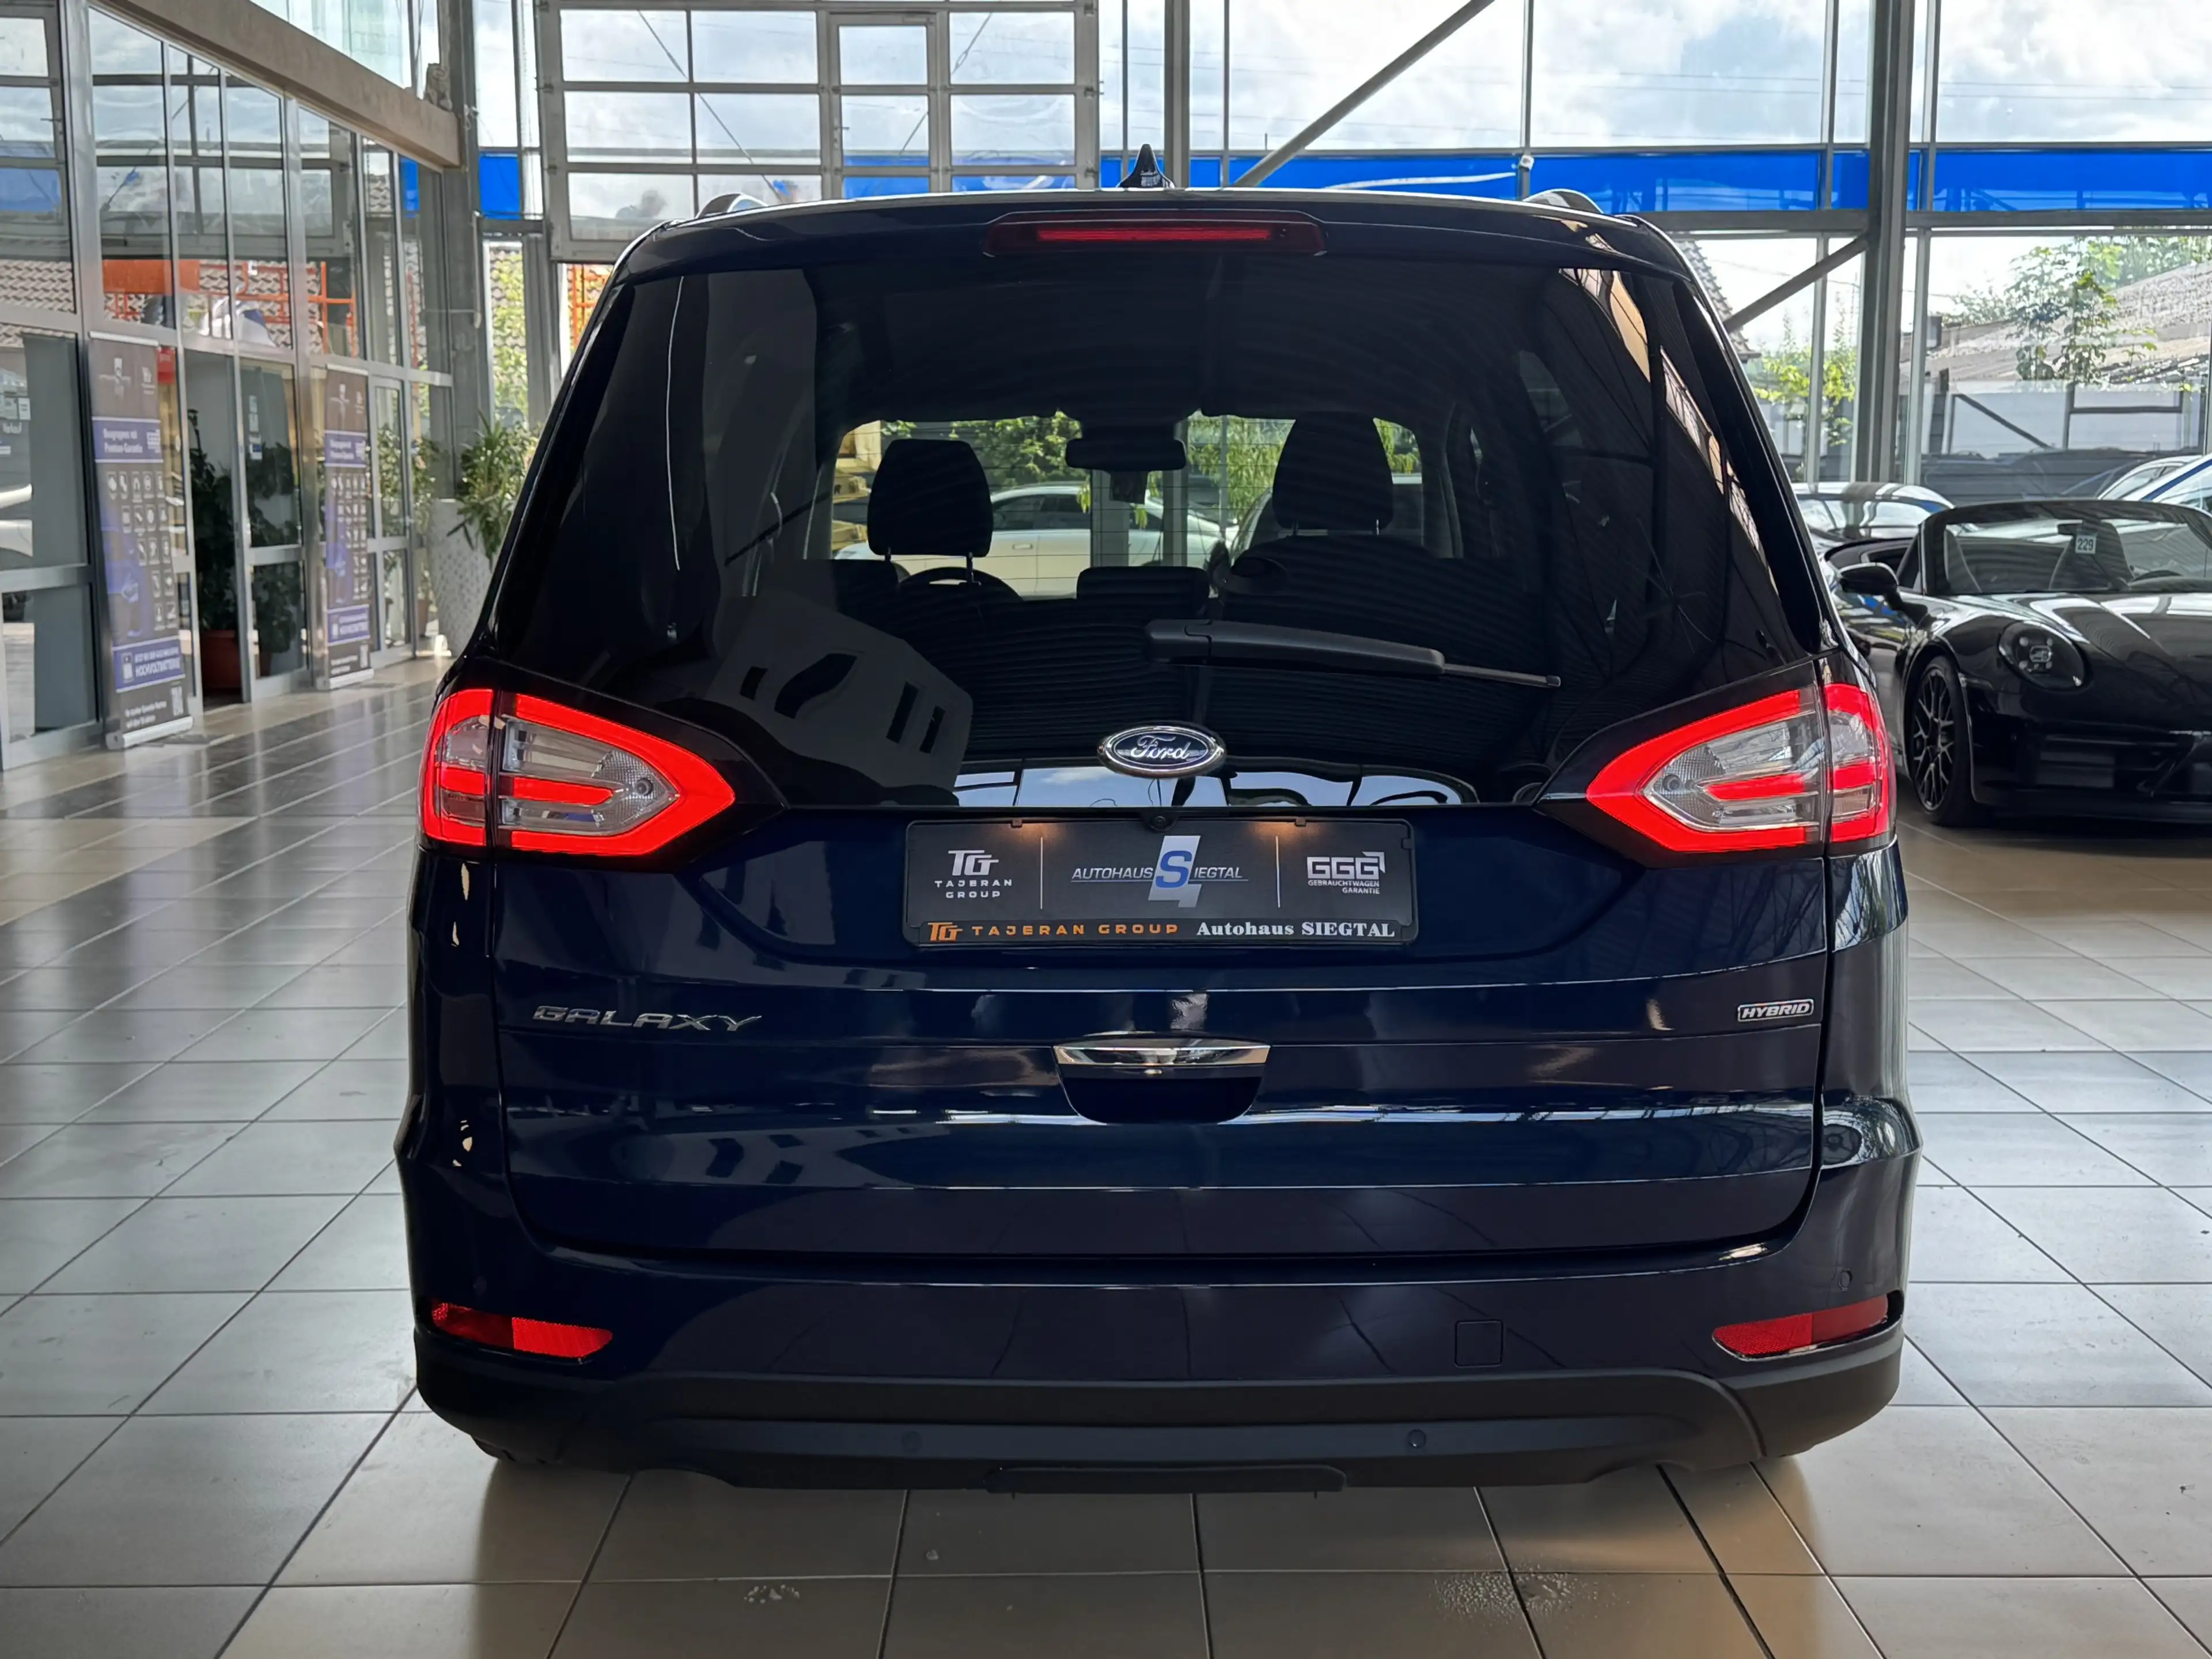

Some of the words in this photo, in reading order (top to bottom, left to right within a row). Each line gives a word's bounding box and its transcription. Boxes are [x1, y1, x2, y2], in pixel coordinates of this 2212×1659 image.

[2077, 537, 2093, 551] 229
[1130, 735, 1191, 760] Ford
[1071, 867, 1153, 880] AUTOHAUS
[1306, 857, 1379, 880] GGG
[934, 879, 1012, 888] TAJERAN
[946, 891, 1000, 899] GROUP
[972, 925, 1085, 936] TAJERAN
[1098, 924, 1178, 934] GROUP
[1196, 922, 1294, 935] Autohaus
[1301, 922, 1395, 937] SIEGTAL
[533, 1005, 762, 1031] GALAXY
[1741, 1003, 1810, 1018] HYBRID
